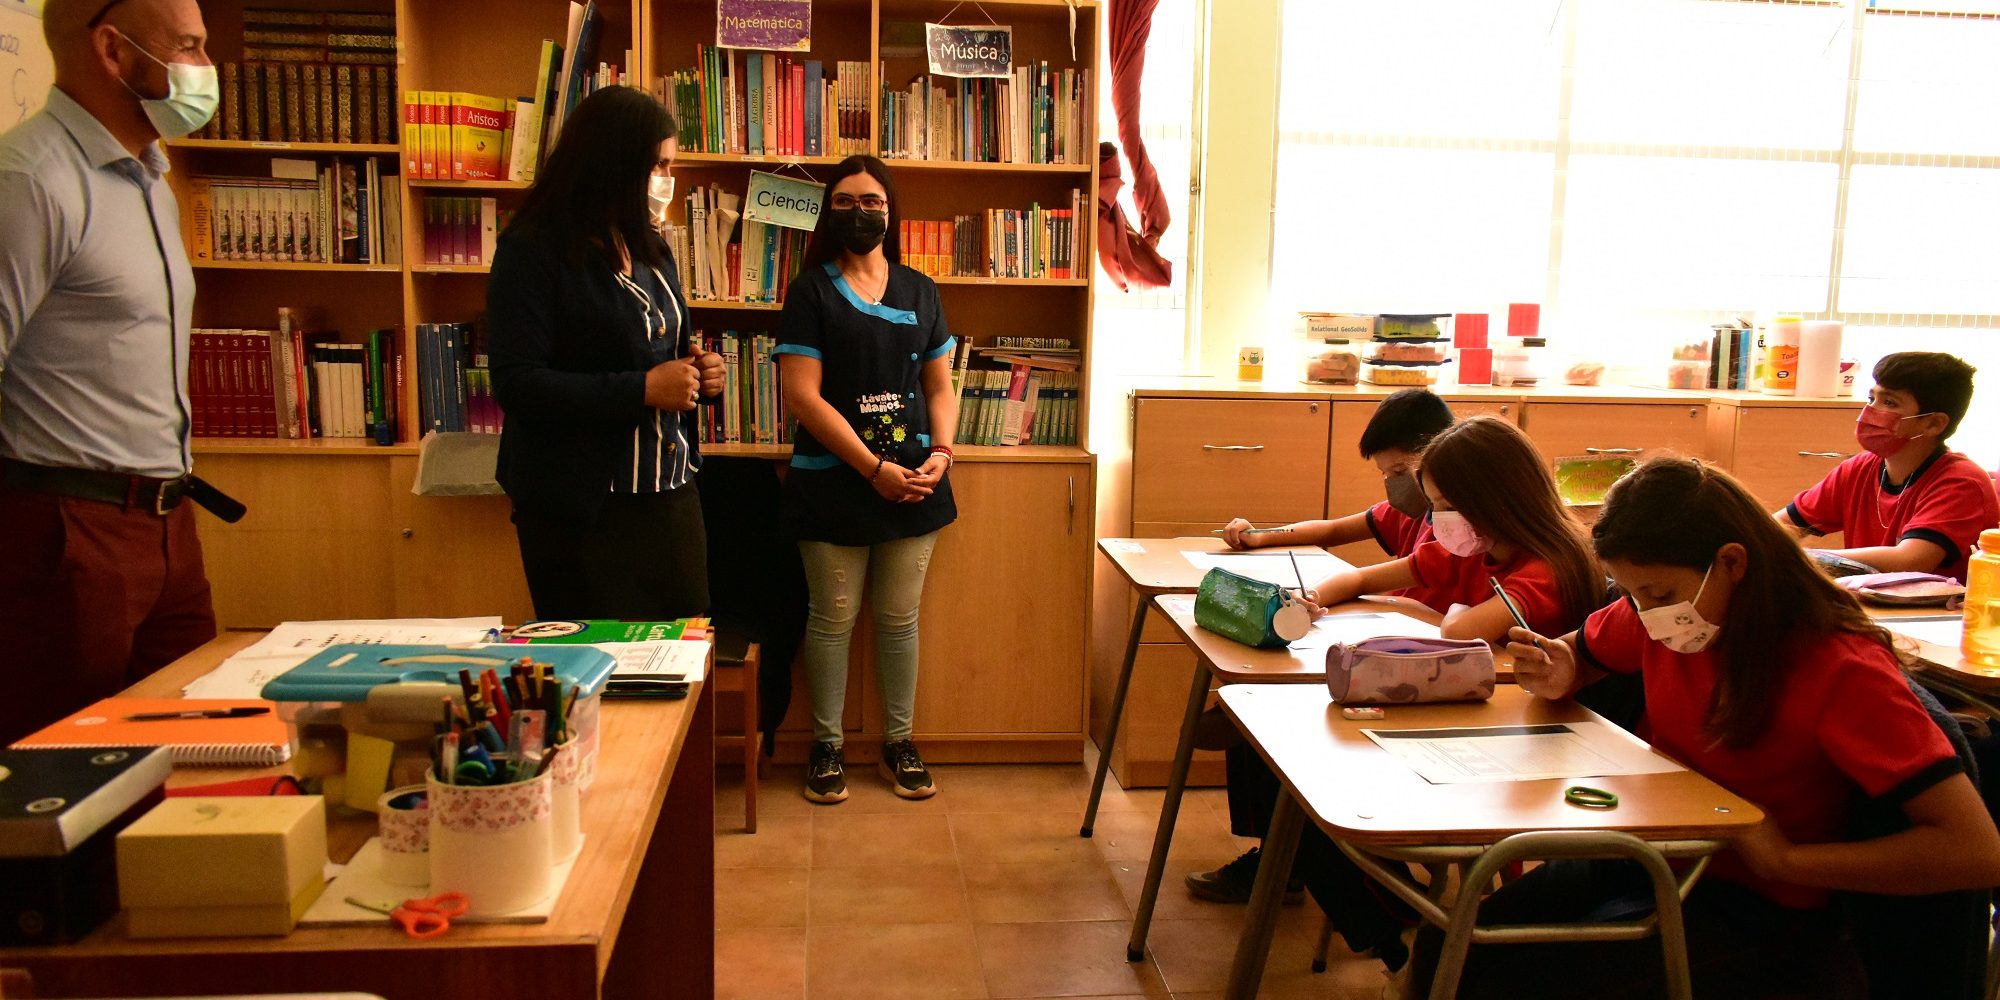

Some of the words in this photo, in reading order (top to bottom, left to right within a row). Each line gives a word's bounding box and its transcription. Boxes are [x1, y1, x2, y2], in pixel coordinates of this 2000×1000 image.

[725, 15, 803, 30] Matemática
[941, 42, 998, 61] Música
[467, 110, 500, 127] Aristos
[757, 190, 819, 216] Ciencia
[862, 392, 898, 404] Lávate
[860, 400, 900, 414] Manos
